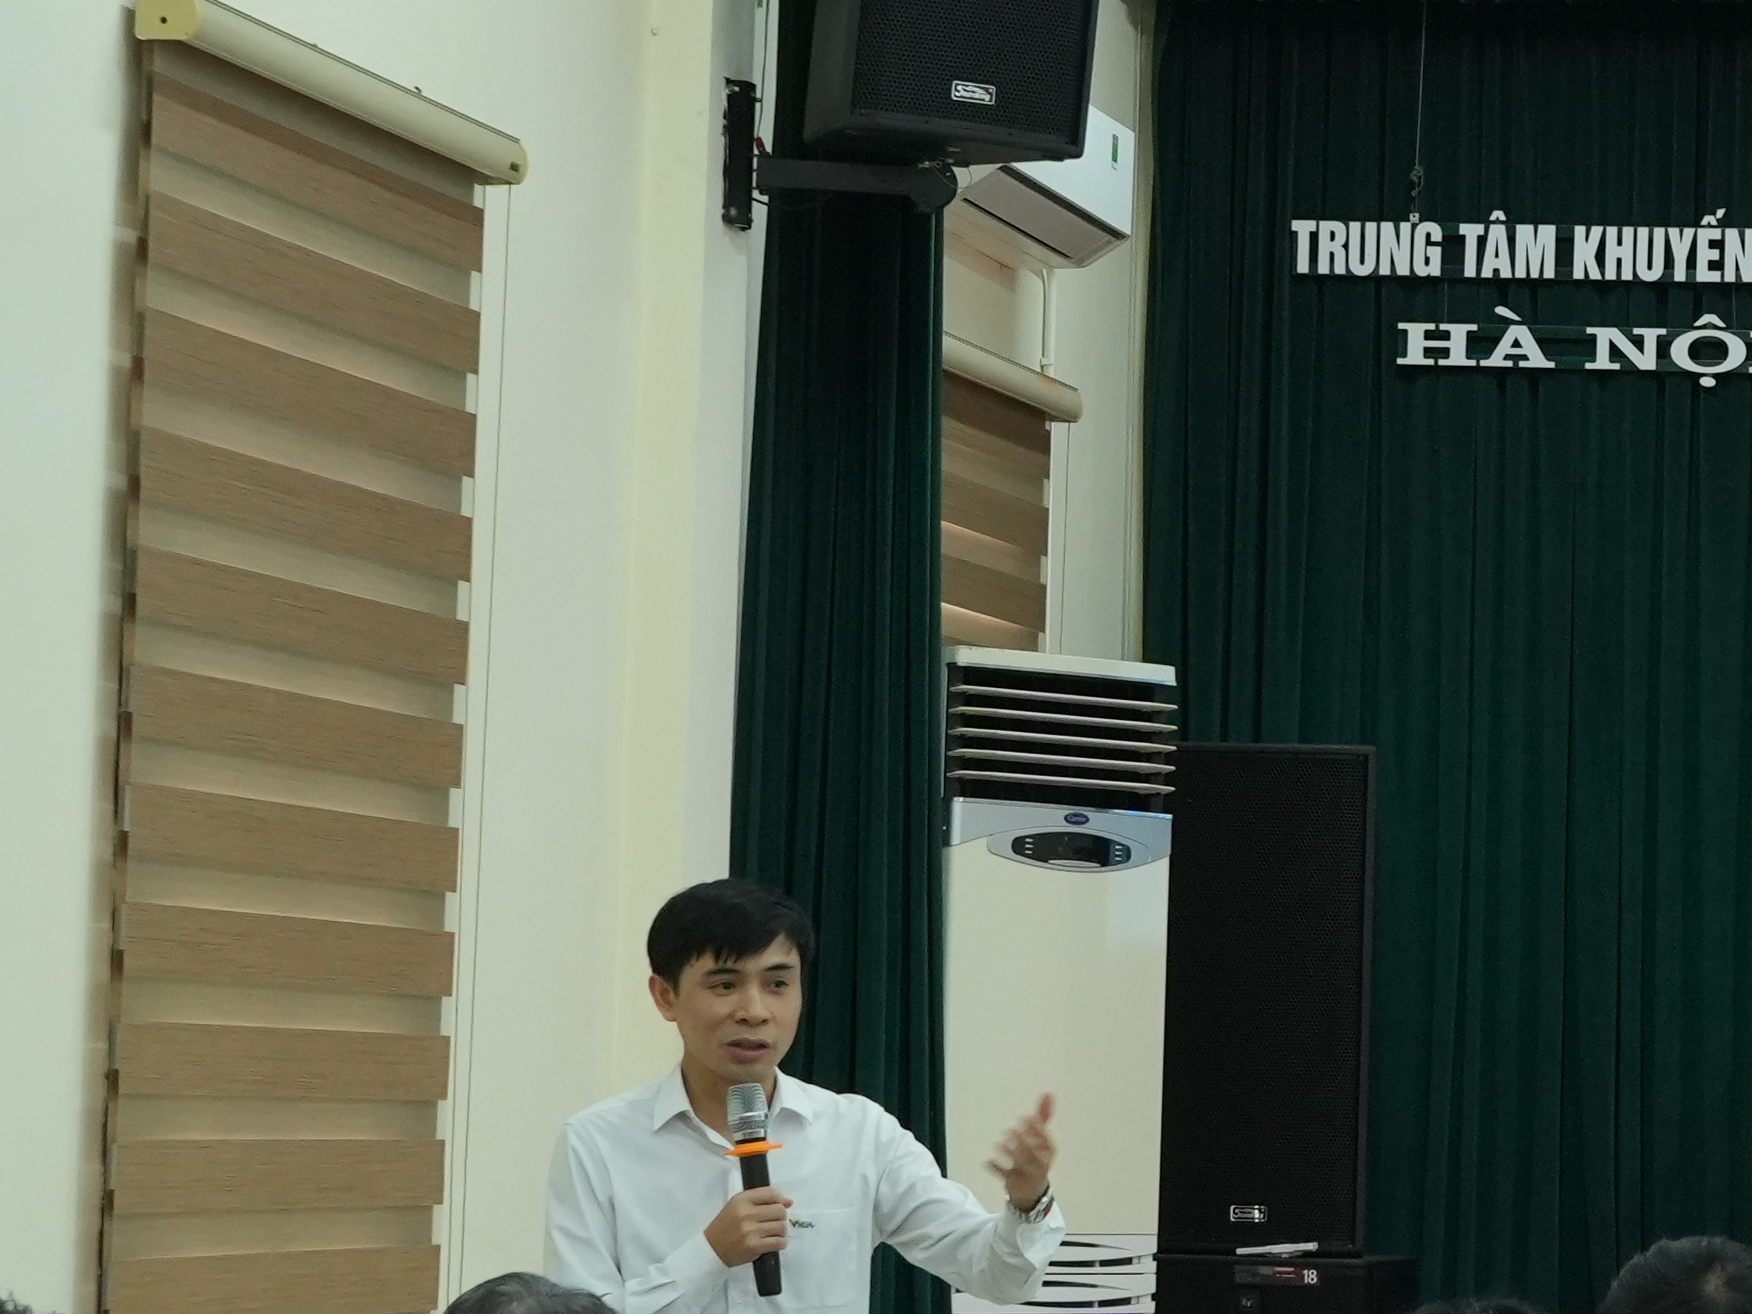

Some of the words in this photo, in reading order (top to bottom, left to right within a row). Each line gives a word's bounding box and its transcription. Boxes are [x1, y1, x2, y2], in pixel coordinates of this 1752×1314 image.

[1290, 219, 1443, 277] TRUNG
[1459, 210, 1557, 279] TÂM
[1396, 305, 1556, 368] HÀ
[1303, 1269, 1318, 1284] 18
